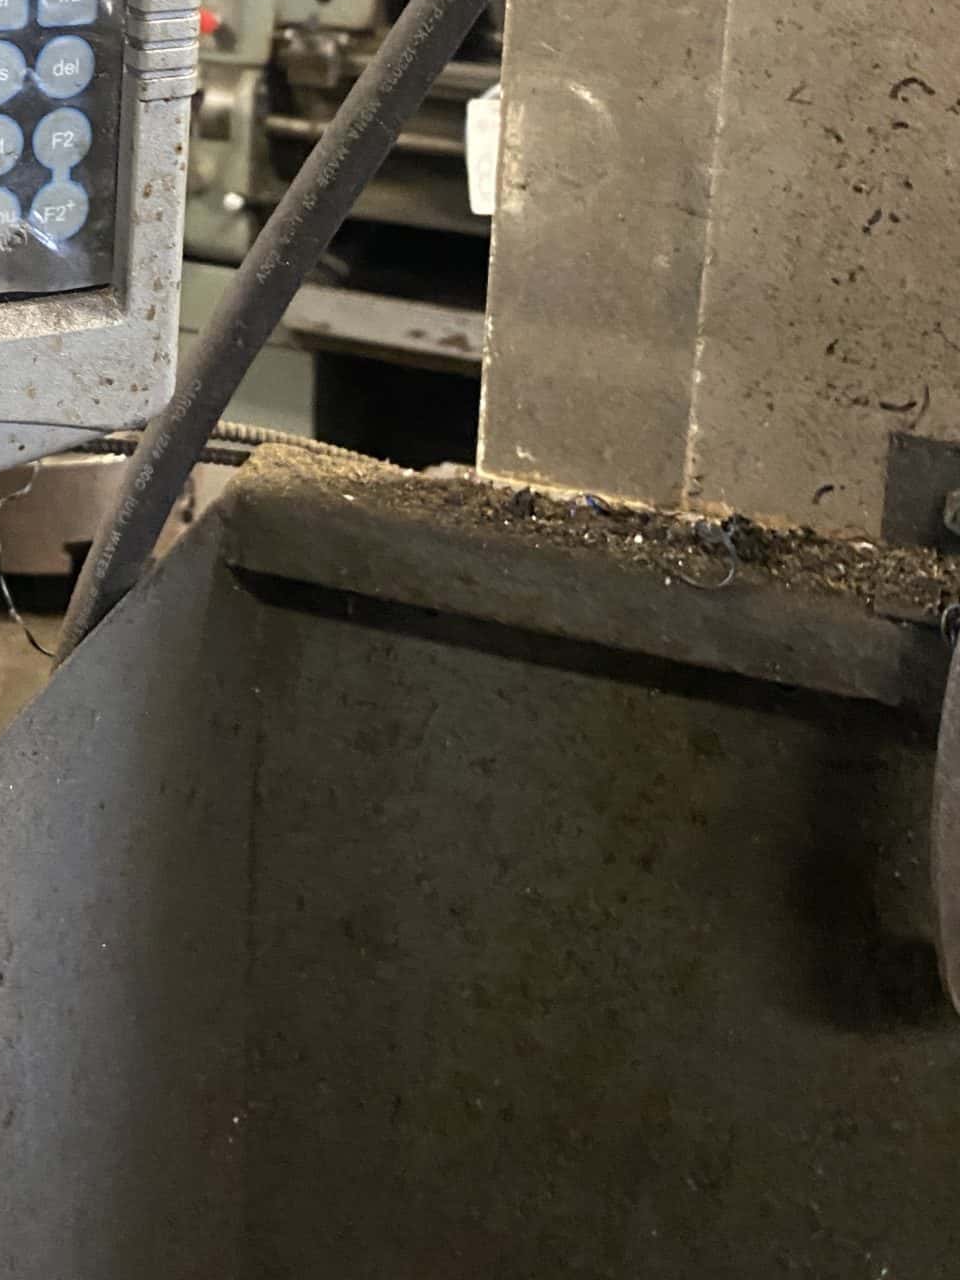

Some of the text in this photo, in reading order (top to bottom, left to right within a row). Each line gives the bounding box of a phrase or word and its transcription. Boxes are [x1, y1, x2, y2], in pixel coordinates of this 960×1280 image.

[52, 58, 79, 77] del
[51, 131, 74, 149] F2
[151, 432, 168, 459] 12/4
[93, 530, 122, 580] WATER
